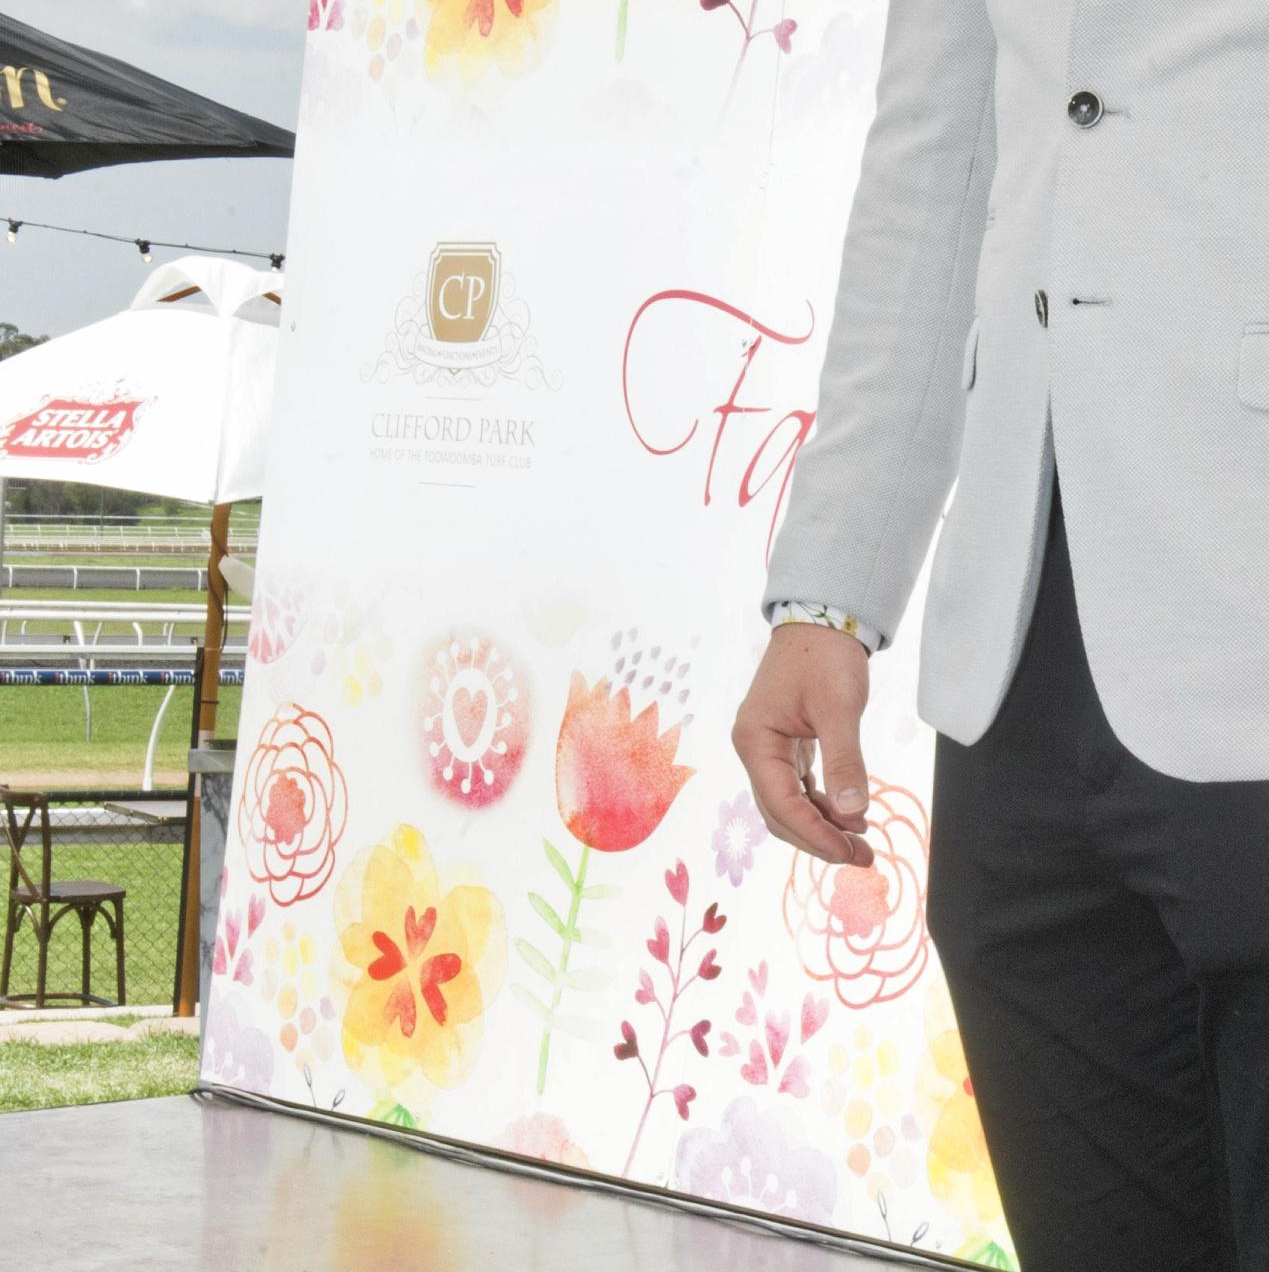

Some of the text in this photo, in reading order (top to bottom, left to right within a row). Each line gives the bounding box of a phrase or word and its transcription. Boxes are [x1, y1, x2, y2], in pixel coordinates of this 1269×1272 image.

[438, 272, 485, 319] CP
[31, 409, 127, 428] STELLA
[372, 414, 536, 448] CLIFFORD PARK
[11, 428, 113, 448] ARTOIS
